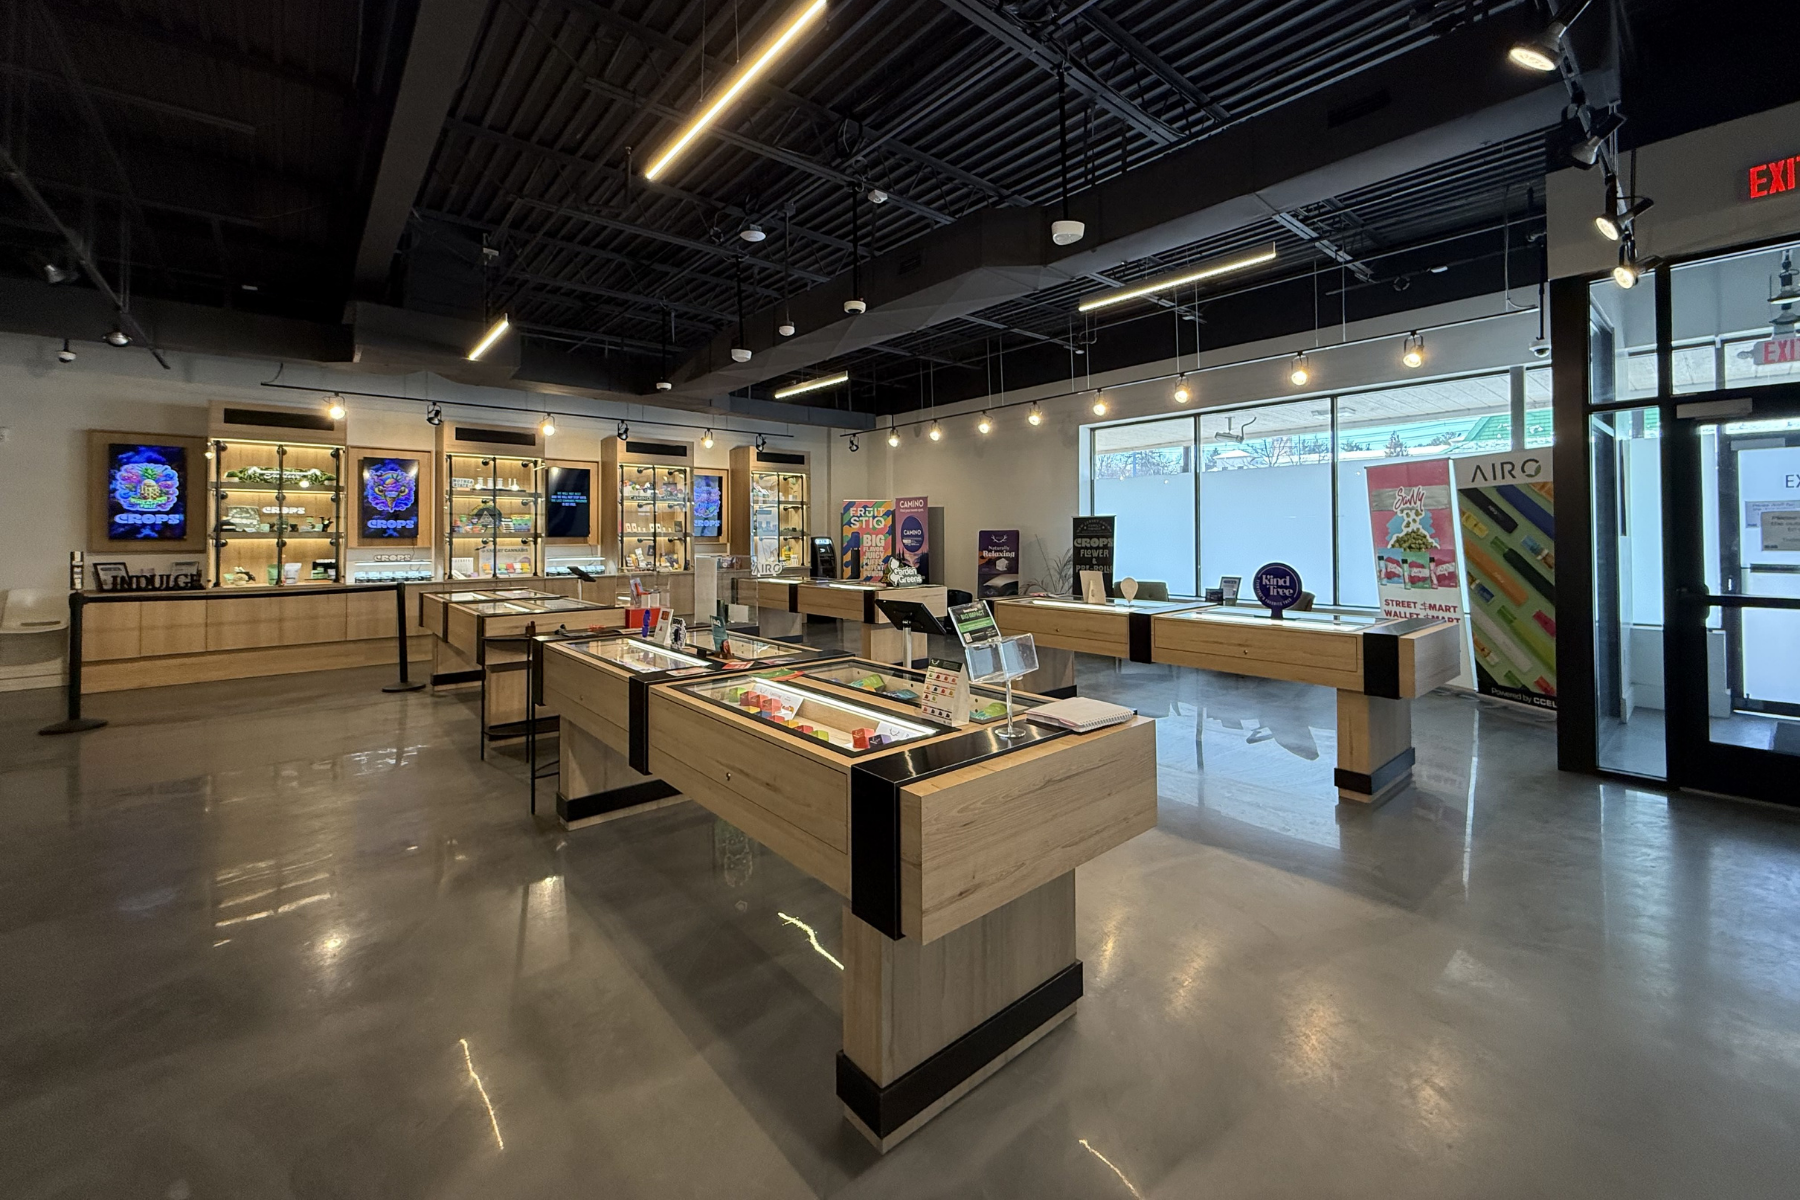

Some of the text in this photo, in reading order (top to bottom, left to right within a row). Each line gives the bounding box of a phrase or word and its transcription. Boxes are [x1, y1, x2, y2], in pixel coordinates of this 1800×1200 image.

[1750, 156, 1800, 199] EXI
[1763, 338, 1800, 364] EXI
[1471, 458, 1542, 483] AIRO
[899, 500, 924, 509] CAMINO
[850, 508, 885, 517] FRUIT
[114, 513, 180, 525] CROPS
[367, 520, 415, 529] CROPS
[850, 517, 886, 529] STIQ
[863, 535, 885, 547] BIG
[1074, 537, 1114, 548] CROPS
[373, 554, 412, 562] CROPS
[982, 550, 1016, 558] Relaxing
[1080, 549, 1109, 558] FLOWER
[752, 563, 783, 574] AIRO
[893, 566, 918, 576] Garden
[110, 573, 202, 590] INDULGE
[899, 573, 922, 583] Greens
[1261, 574, 1291, 587] Kind
[1266, 585, 1294, 597] Tree
[1384, 599, 1418, 609] STREET
[1383, 609, 1421, 619] WALLET
[1491, 687, 1522, 698] Powered
[1522, 694, 1533, 704] by
